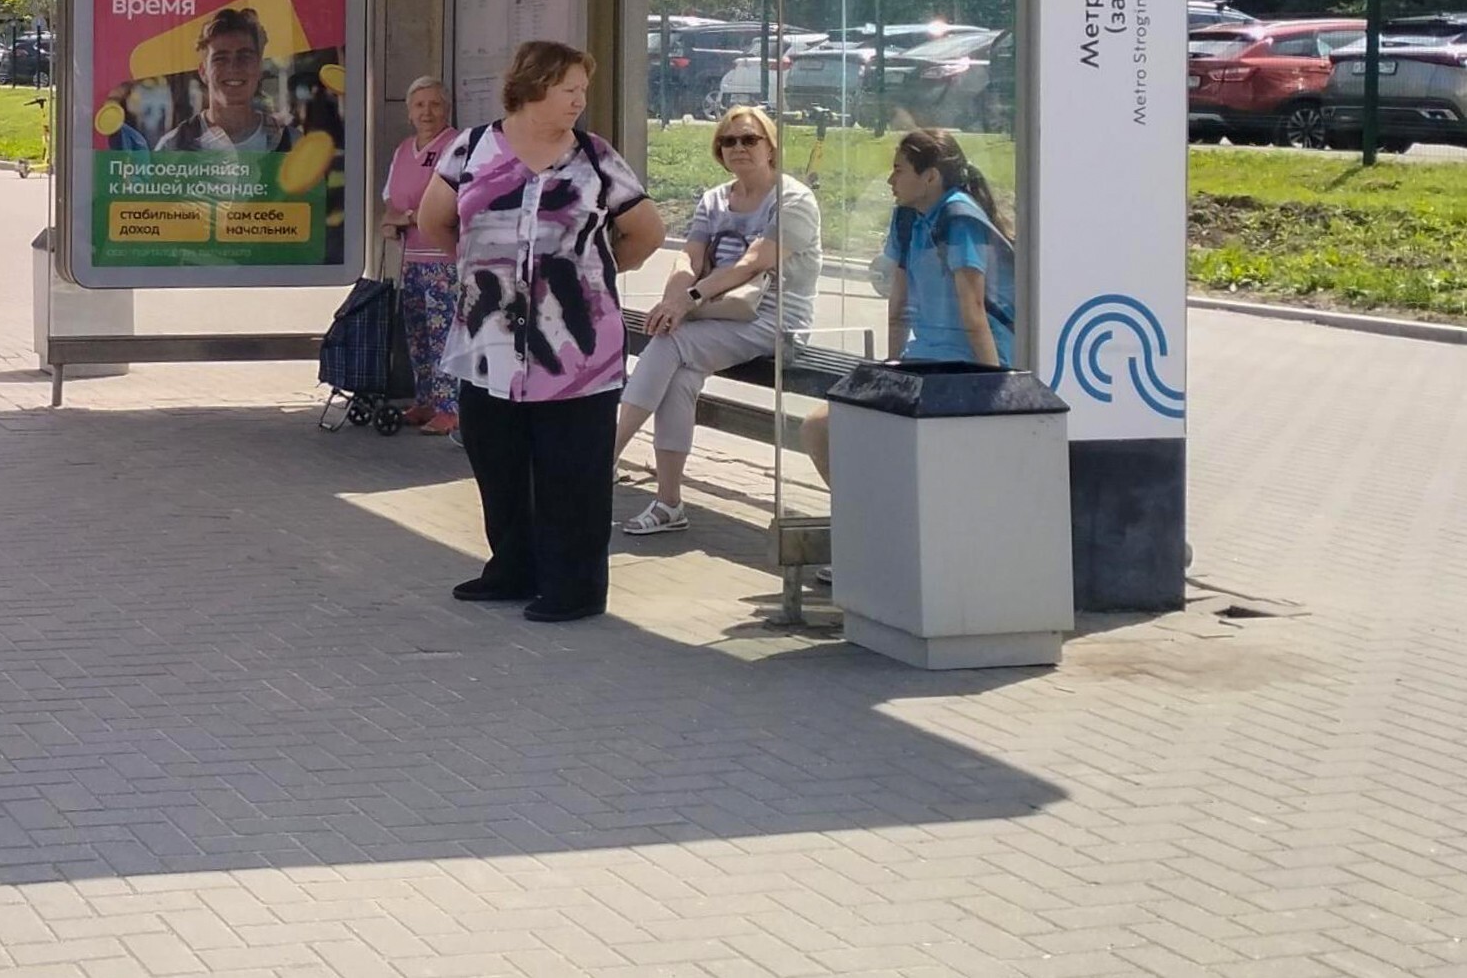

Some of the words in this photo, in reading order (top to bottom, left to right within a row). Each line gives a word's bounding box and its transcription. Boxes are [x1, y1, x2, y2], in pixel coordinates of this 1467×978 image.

[1133, 68, 1147, 125] Metro
[109, 159, 250, 178] Присоединяйся
[109, 182, 118, 195] к
[122, 180, 183, 195] нашей
[186, 182, 269, 197] команде:
[120, 207, 201, 220] стабильный
[227, 211, 251, 221] сам
[254, 209, 284, 221] себе
[119, 224, 160, 237] доход
[226, 225, 298, 236] начальник
